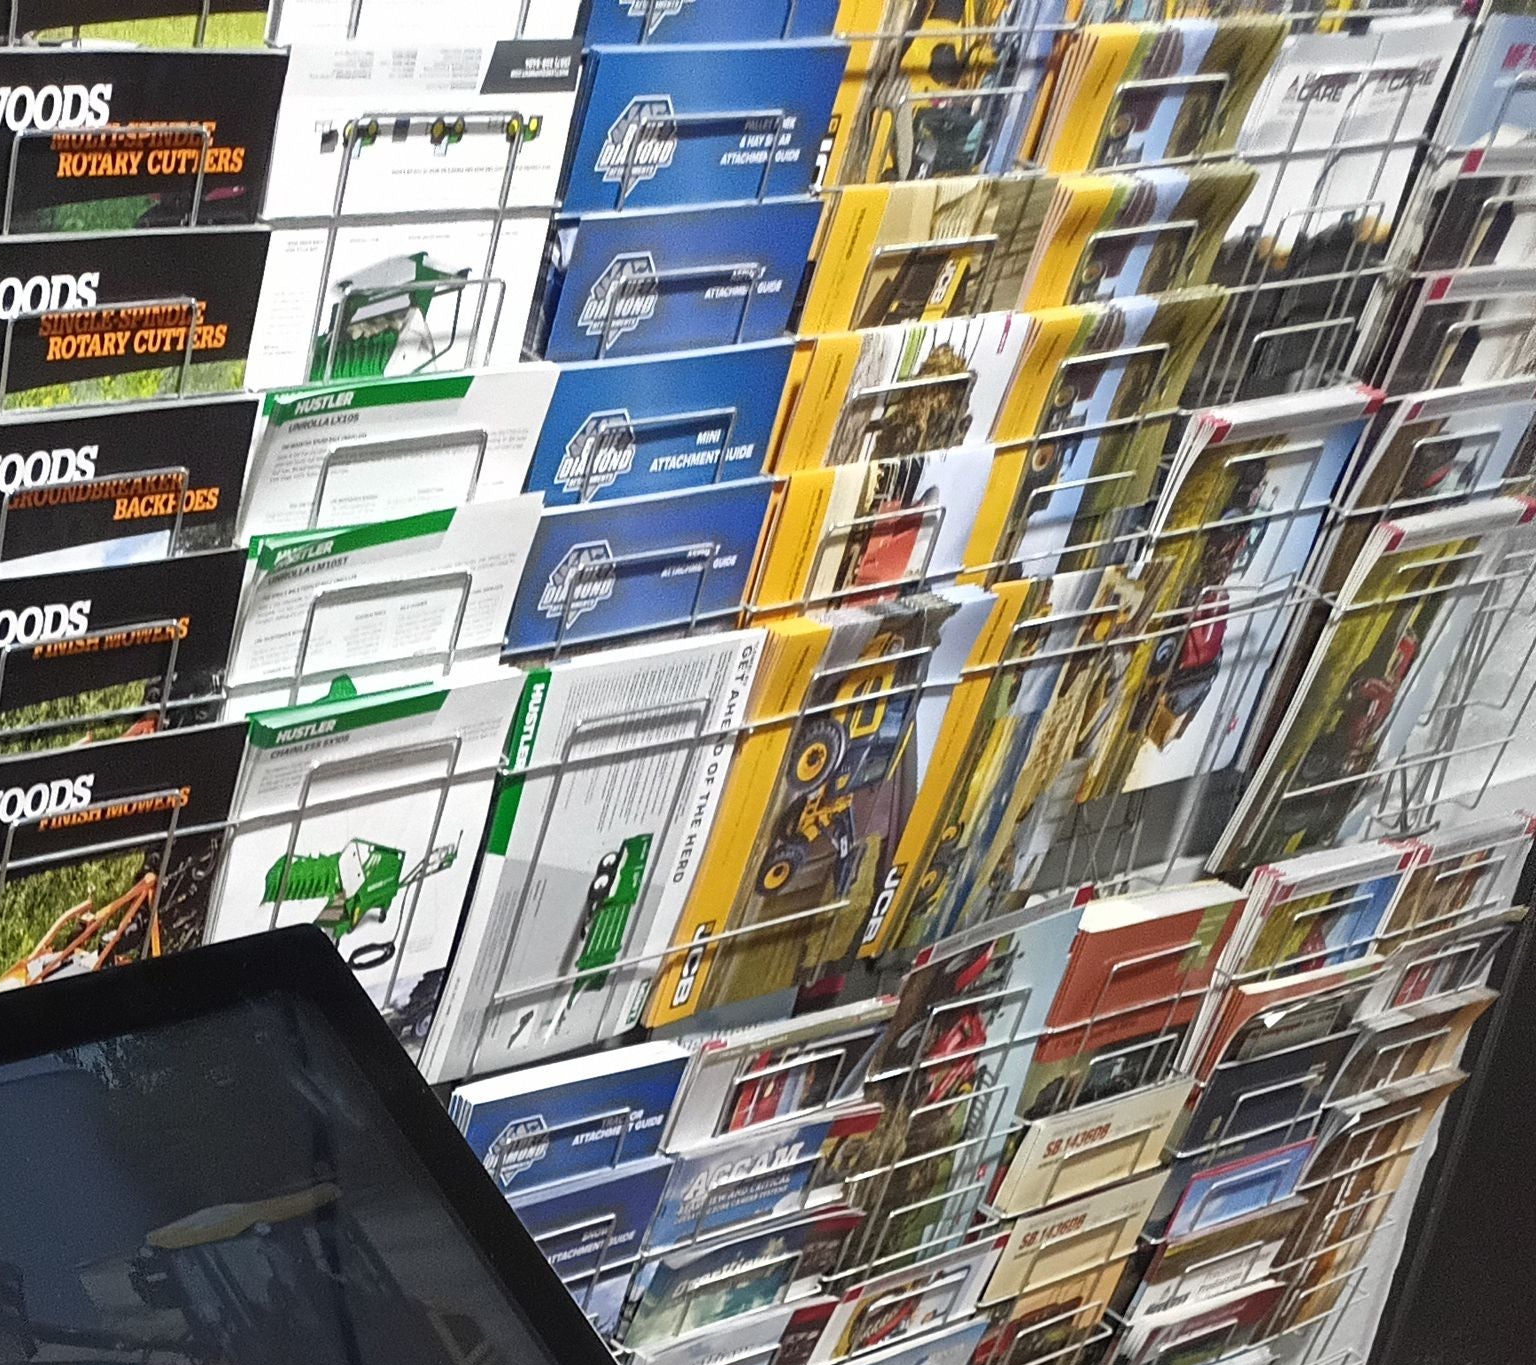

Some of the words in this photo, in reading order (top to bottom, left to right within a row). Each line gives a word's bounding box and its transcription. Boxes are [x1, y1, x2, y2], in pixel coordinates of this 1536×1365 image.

[56, 150, 144, 178] ROTARY
[46, 330, 129, 361] ROTARY
[133, 324, 227, 355] CUTTERS
[295, 391, 354, 415] HUSTLER
[288, 415, 331, 433] UNROLLA
[696, 429, 722, 446] MINI
[649, 449, 720, 473] ATTACHMENT
[274, 540, 334, 570] HUSTLER
[735, 645, 753, 681] GET
[276, 719, 337, 744] HUSTLER
[705, 762, 719, 786] OF
[690, 792, 710, 828] THE
[672, 834, 697, 883] HERD
[862, 865, 900, 945] JCB
[635, 1114, 664, 1131] GUIDE
